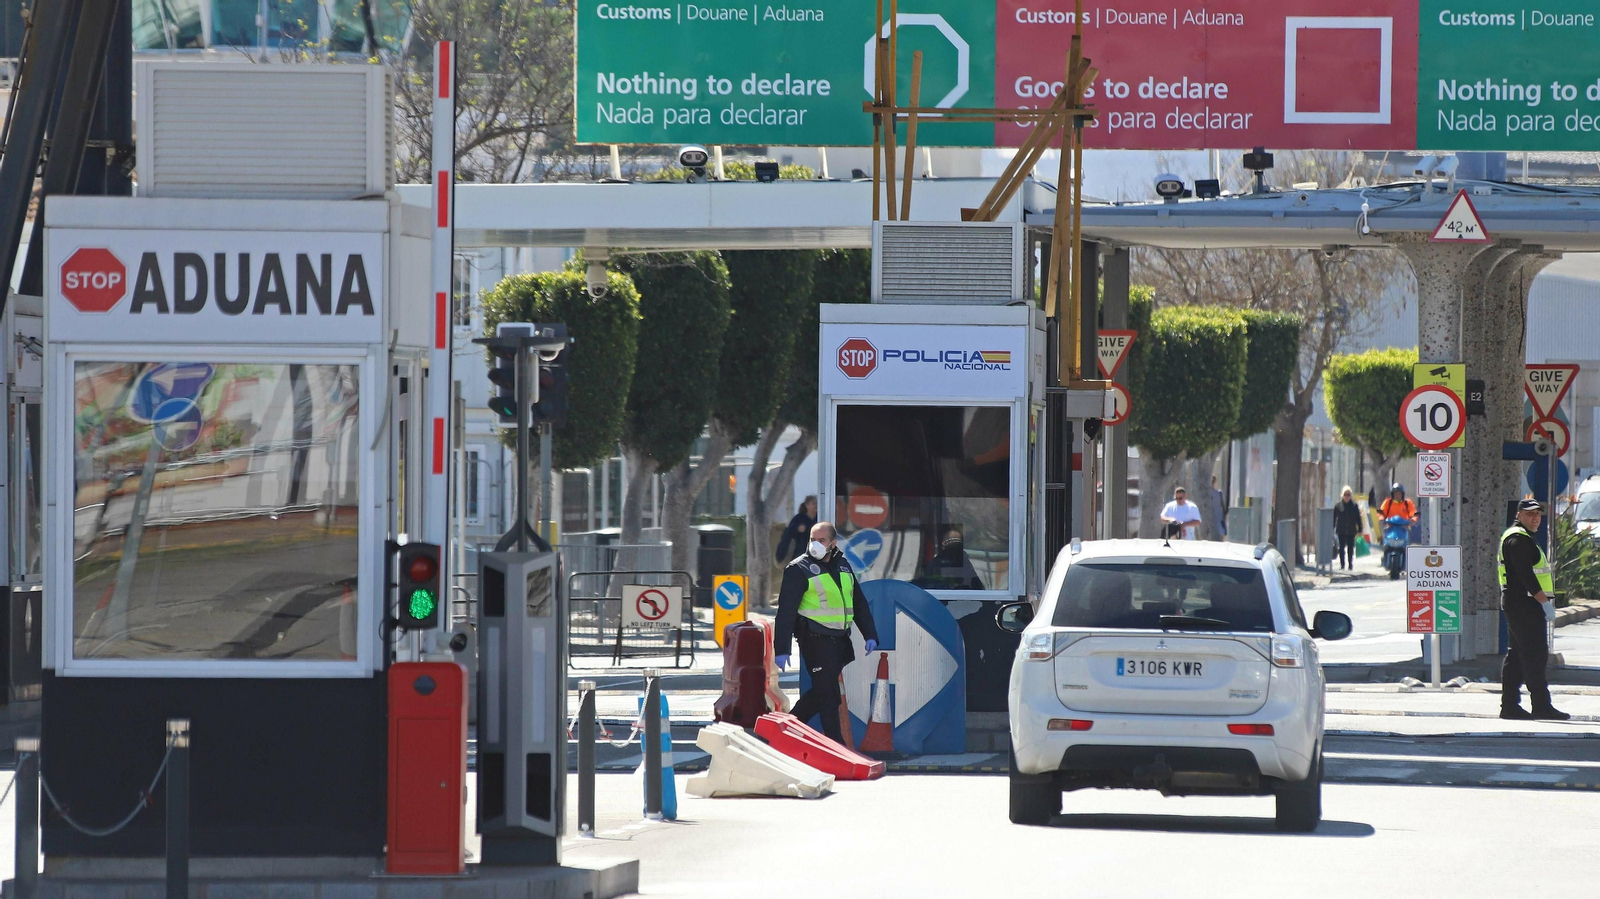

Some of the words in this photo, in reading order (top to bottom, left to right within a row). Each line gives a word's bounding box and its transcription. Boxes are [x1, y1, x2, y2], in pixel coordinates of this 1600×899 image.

[597, 4, 672, 20] Customs
[687, 4, 748, 21] Douane
[763, 5, 824, 22] Aduana
[1106, 9, 1168, 25] Douane
[1183, 9, 1244, 26] Aduana
[1439, 10, 1515, 26] Customs
[1531, 10, 1594, 26] Douane
[597, 71, 698, 101] Nothing
[706, 75, 733, 95] to
[741, 72, 831, 96] declare
[1014, 76, 1095, 99] Goos
[1103, 78, 1130, 99] to
[1138, 76, 1229, 99] declare
[1438, 78, 1541, 107] Nothing
[1550, 81, 1578, 101] to
[597, 101, 654, 124] Nada
[663, 107, 711, 130] para
[720, 102, 808, 125] declarar
[1108, 111, 1156, 134] para
[1165, 106, 1253, 130] declarar
[1438, 108, 1496, 131] Nada
[1506, 114, 1555, 137] para
[65, 271, 121, 289] STOP
[129, 251, 375, 316] ADUANA
[841, 349, 874, 367] STOP
[944, 363, 1011, 371] NACIONAL
[1529, 370, 1563, 382] GIVE
[1471, 392, 1482, 402] E2
[1534, 384, 1559, 393] WAY
[1413, 402, 1453, 432] 10
[1409, 570, 1459, 579] CUSTOMS
[1127, 660, 1167, 675] 3106
[1173, 661, 1203, 676] KWR
